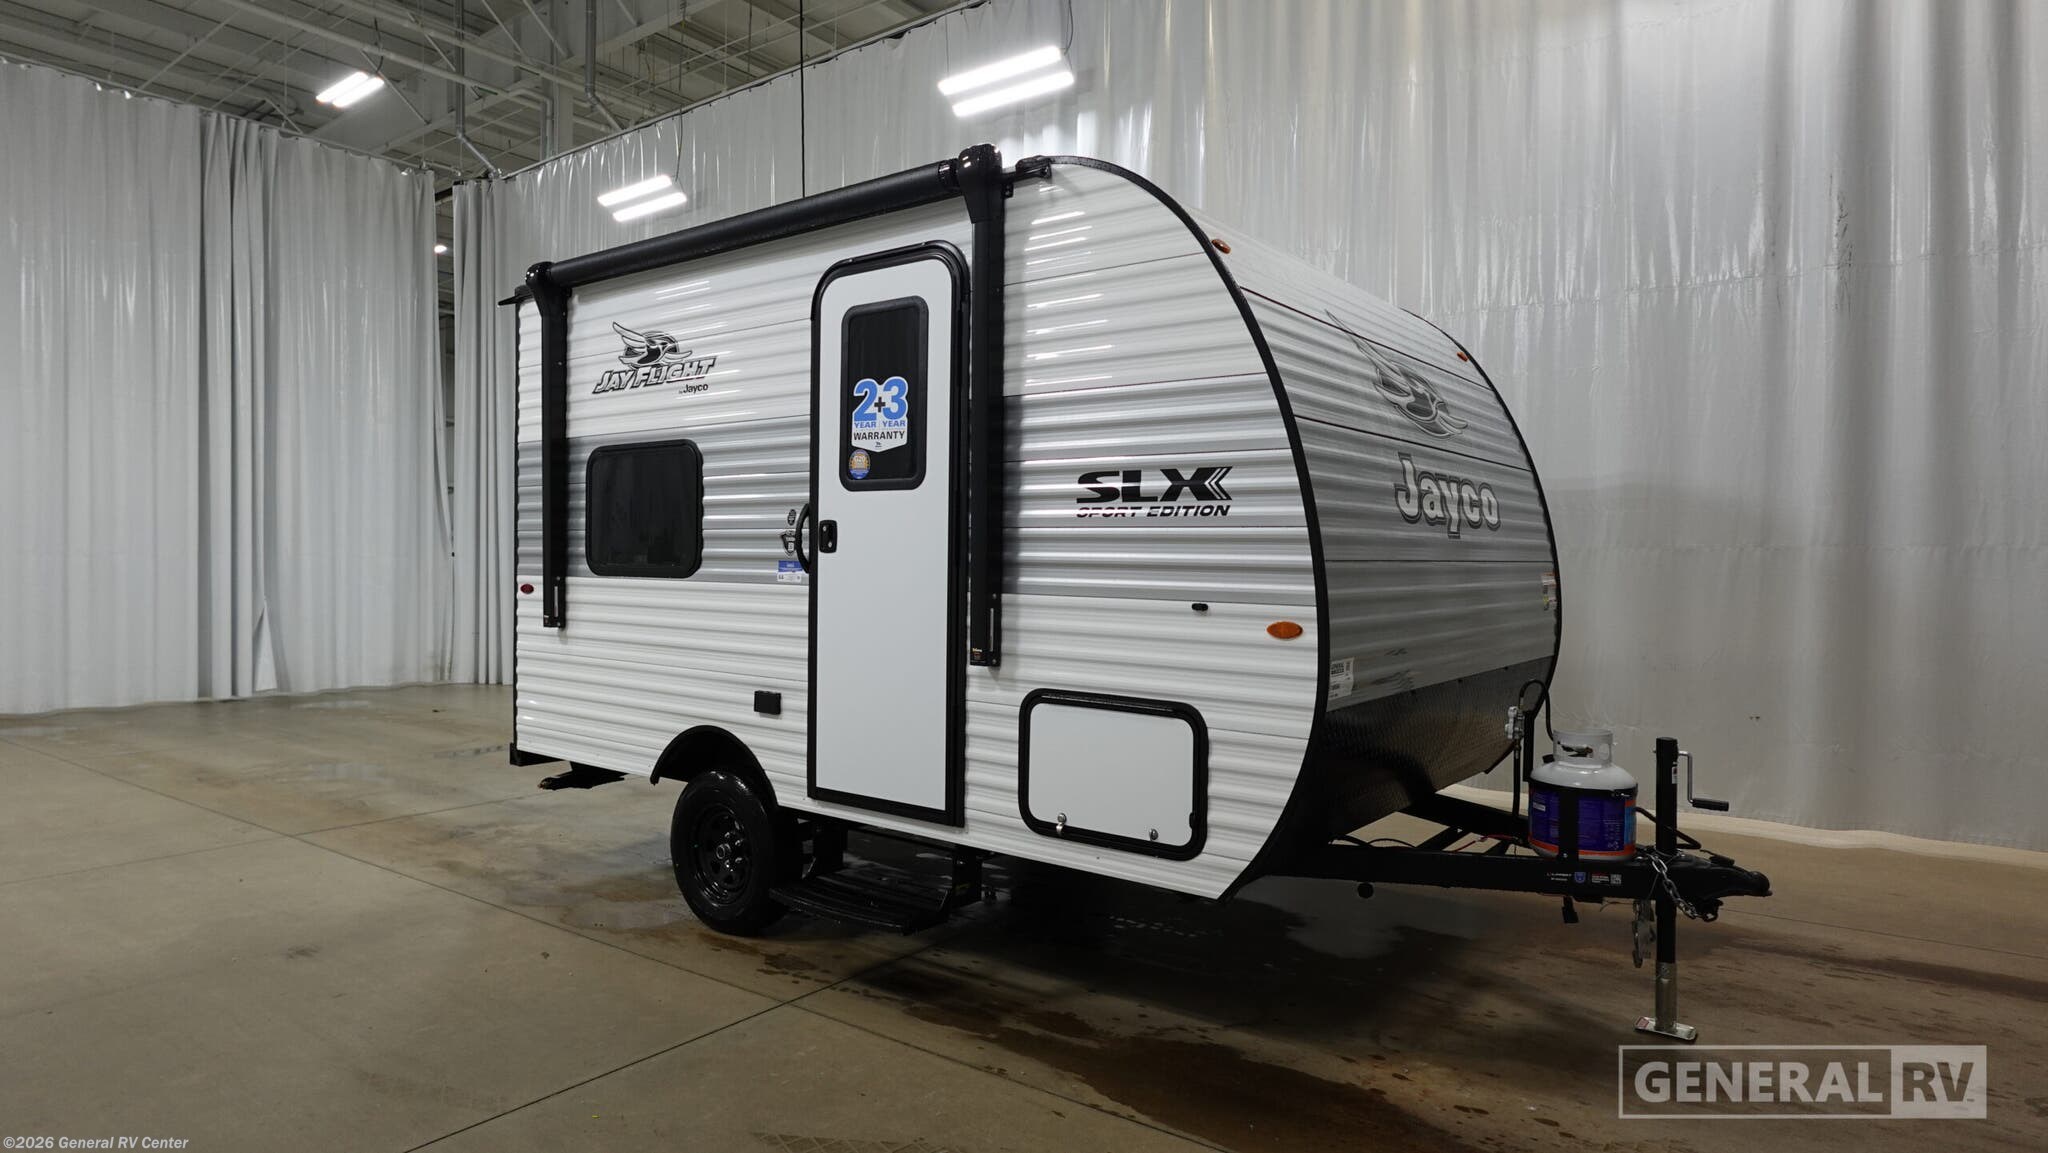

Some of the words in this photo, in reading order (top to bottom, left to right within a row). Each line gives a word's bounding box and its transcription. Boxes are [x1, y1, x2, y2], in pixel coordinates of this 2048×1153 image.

[592, 369, 636, 394] JAY
[631, 356, 717, 388] FLIGHT
[683, 384, 709, 394] Jayco
[853, 431, 905, 441] WARRANTY
[1076, 466, 1233, 503] SLX
[1394, 452, 1500, 539] Jayco
[1147, 505, 1231, 517] EDITION
